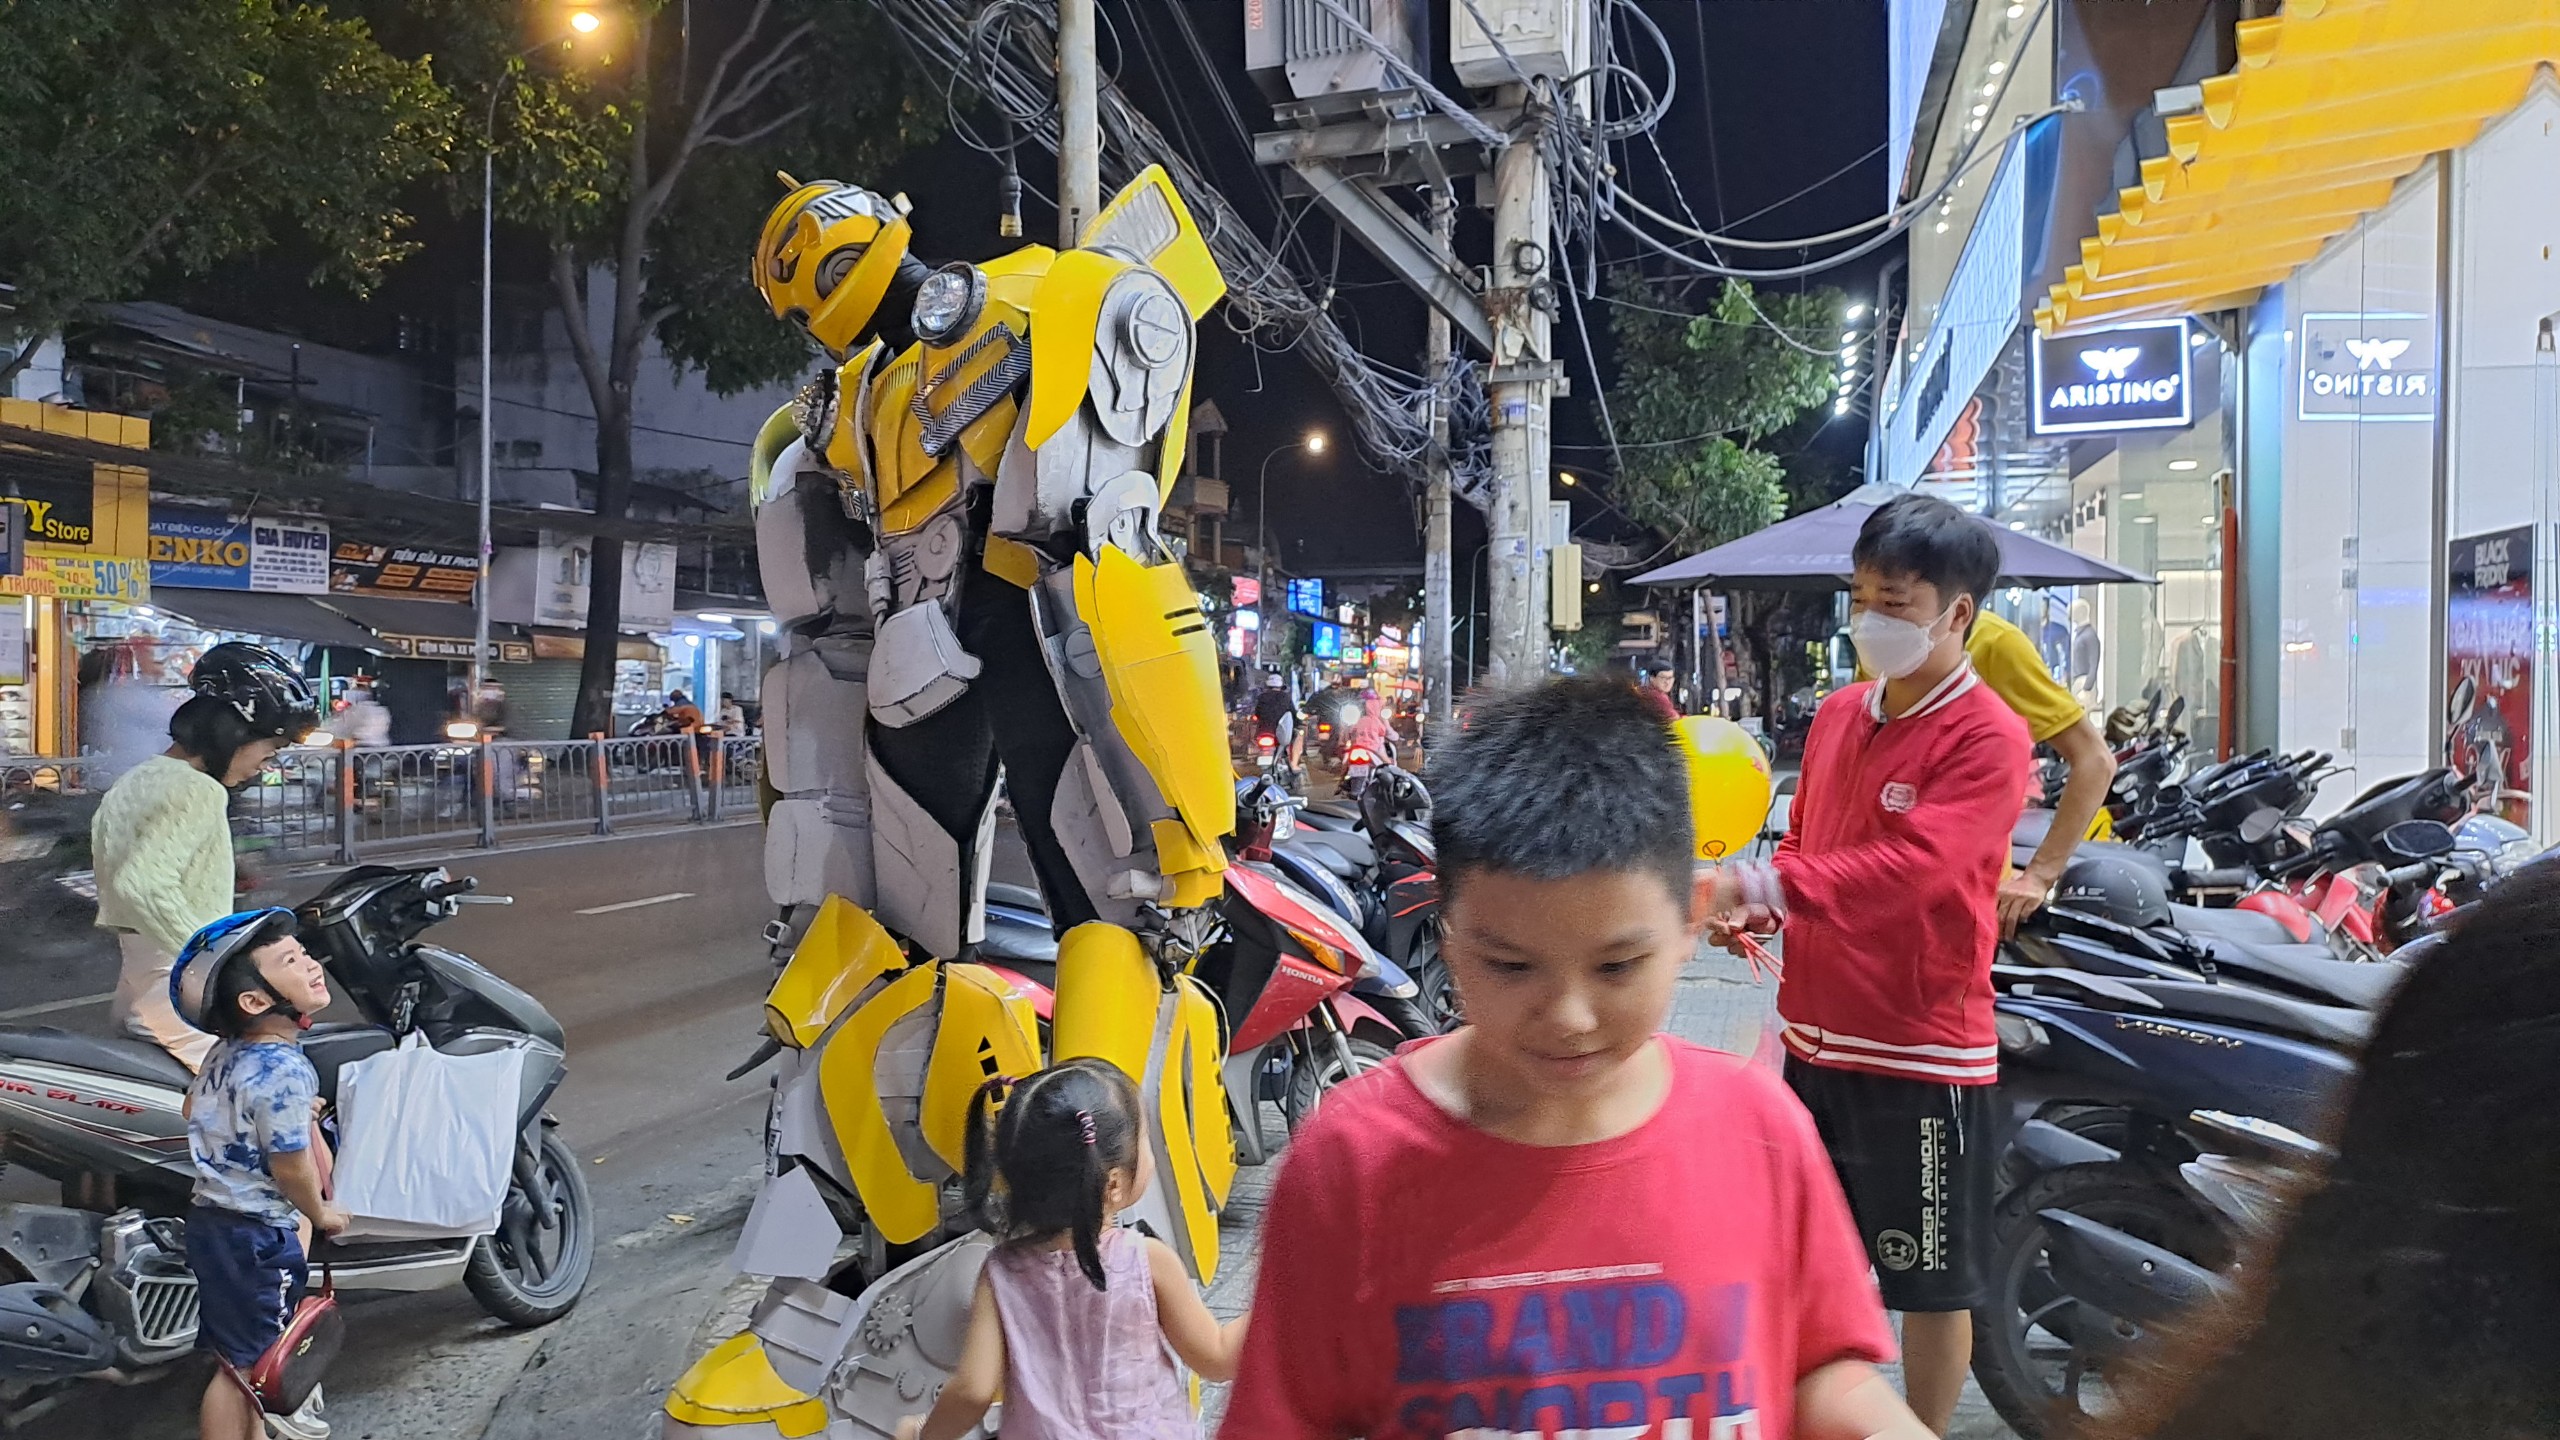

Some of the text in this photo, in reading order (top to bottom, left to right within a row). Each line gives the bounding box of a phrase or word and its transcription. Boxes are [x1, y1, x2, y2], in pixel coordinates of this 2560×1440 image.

[2050, 376, 2176, 409] ARISTINO
[45, 518, 90, 540] Store
[2475, 537, 2510, 567] BLACK
[93, 560, 139, 598] 50%
[1281, 965, 1324, 985] HONDA
[47, 1089, 146, 1115] BLADE
[1920, 1117, 1935, 1271] UNDER ARMOUR
